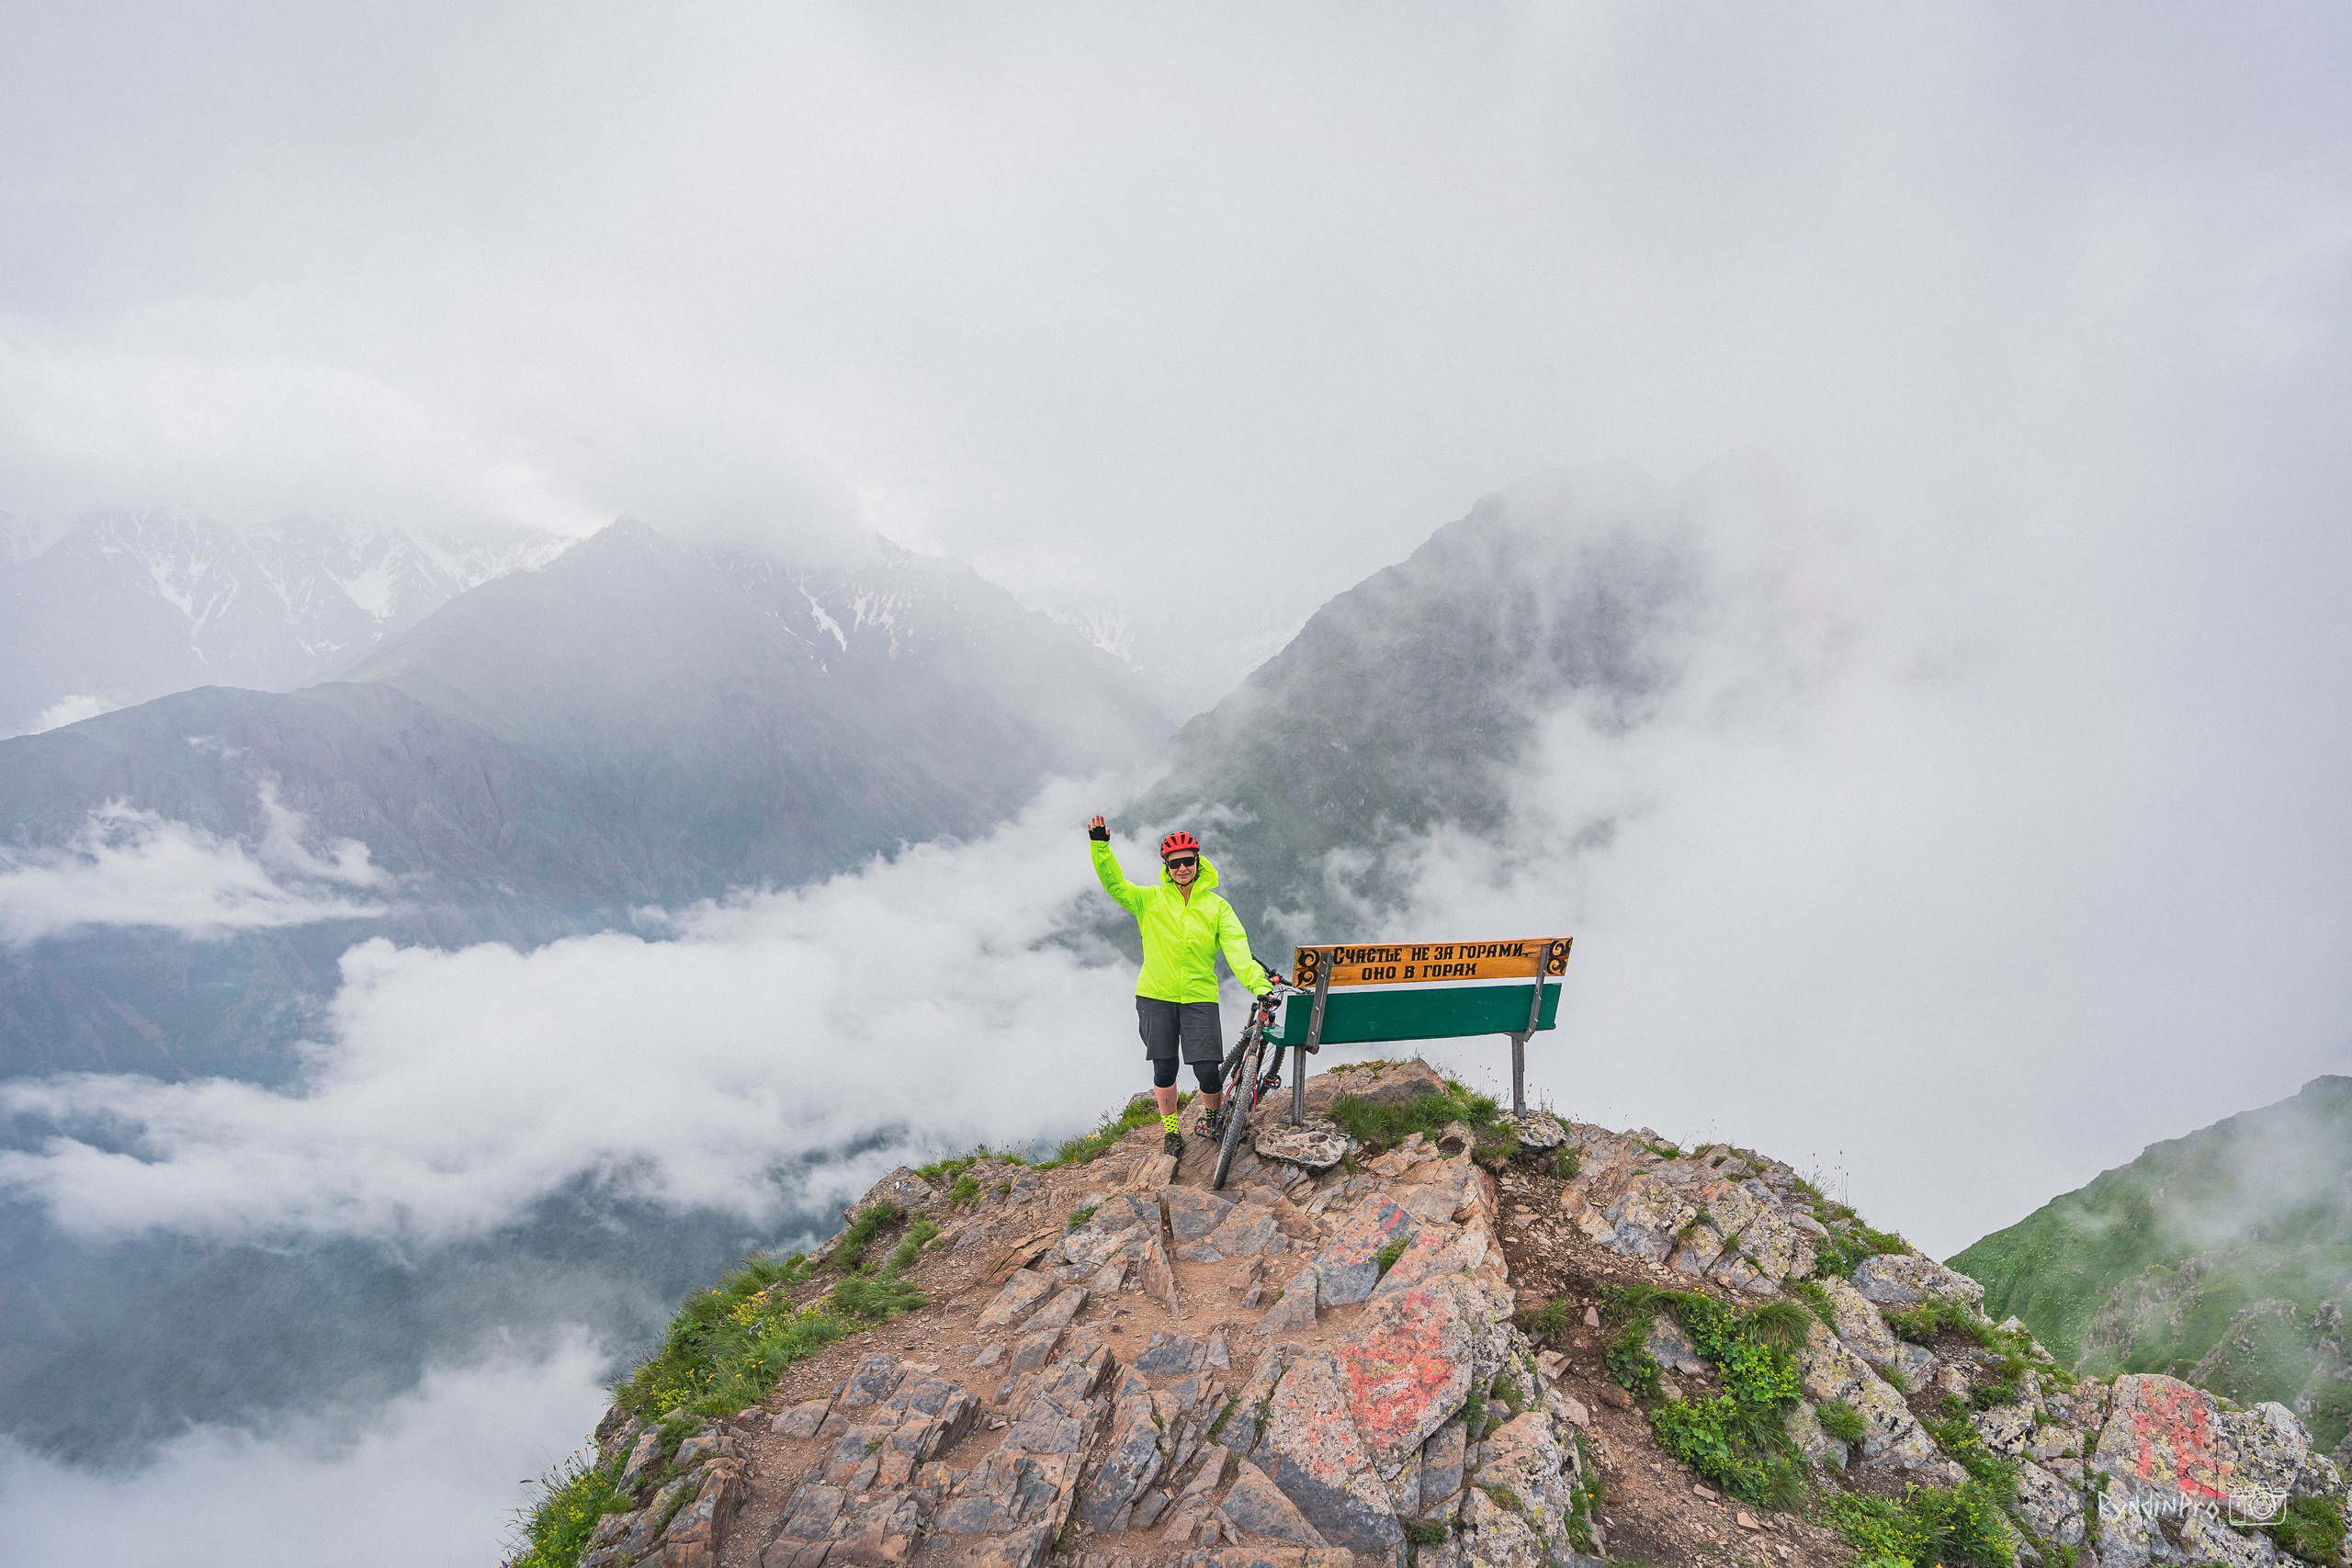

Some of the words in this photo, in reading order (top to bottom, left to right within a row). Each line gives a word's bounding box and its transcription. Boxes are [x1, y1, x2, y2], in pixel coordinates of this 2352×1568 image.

[1332, 946, 1403, 965] СЧАСТЬЕ
[1410, 946, 1430, 962] НЕ
[1433, 945, 1455, 961] ЗА
[1362, 965, 1396, 981] ОНО
[1402, 964, 1416, 979] В
[1421, 962, 1478, 978] ГОРАХ
